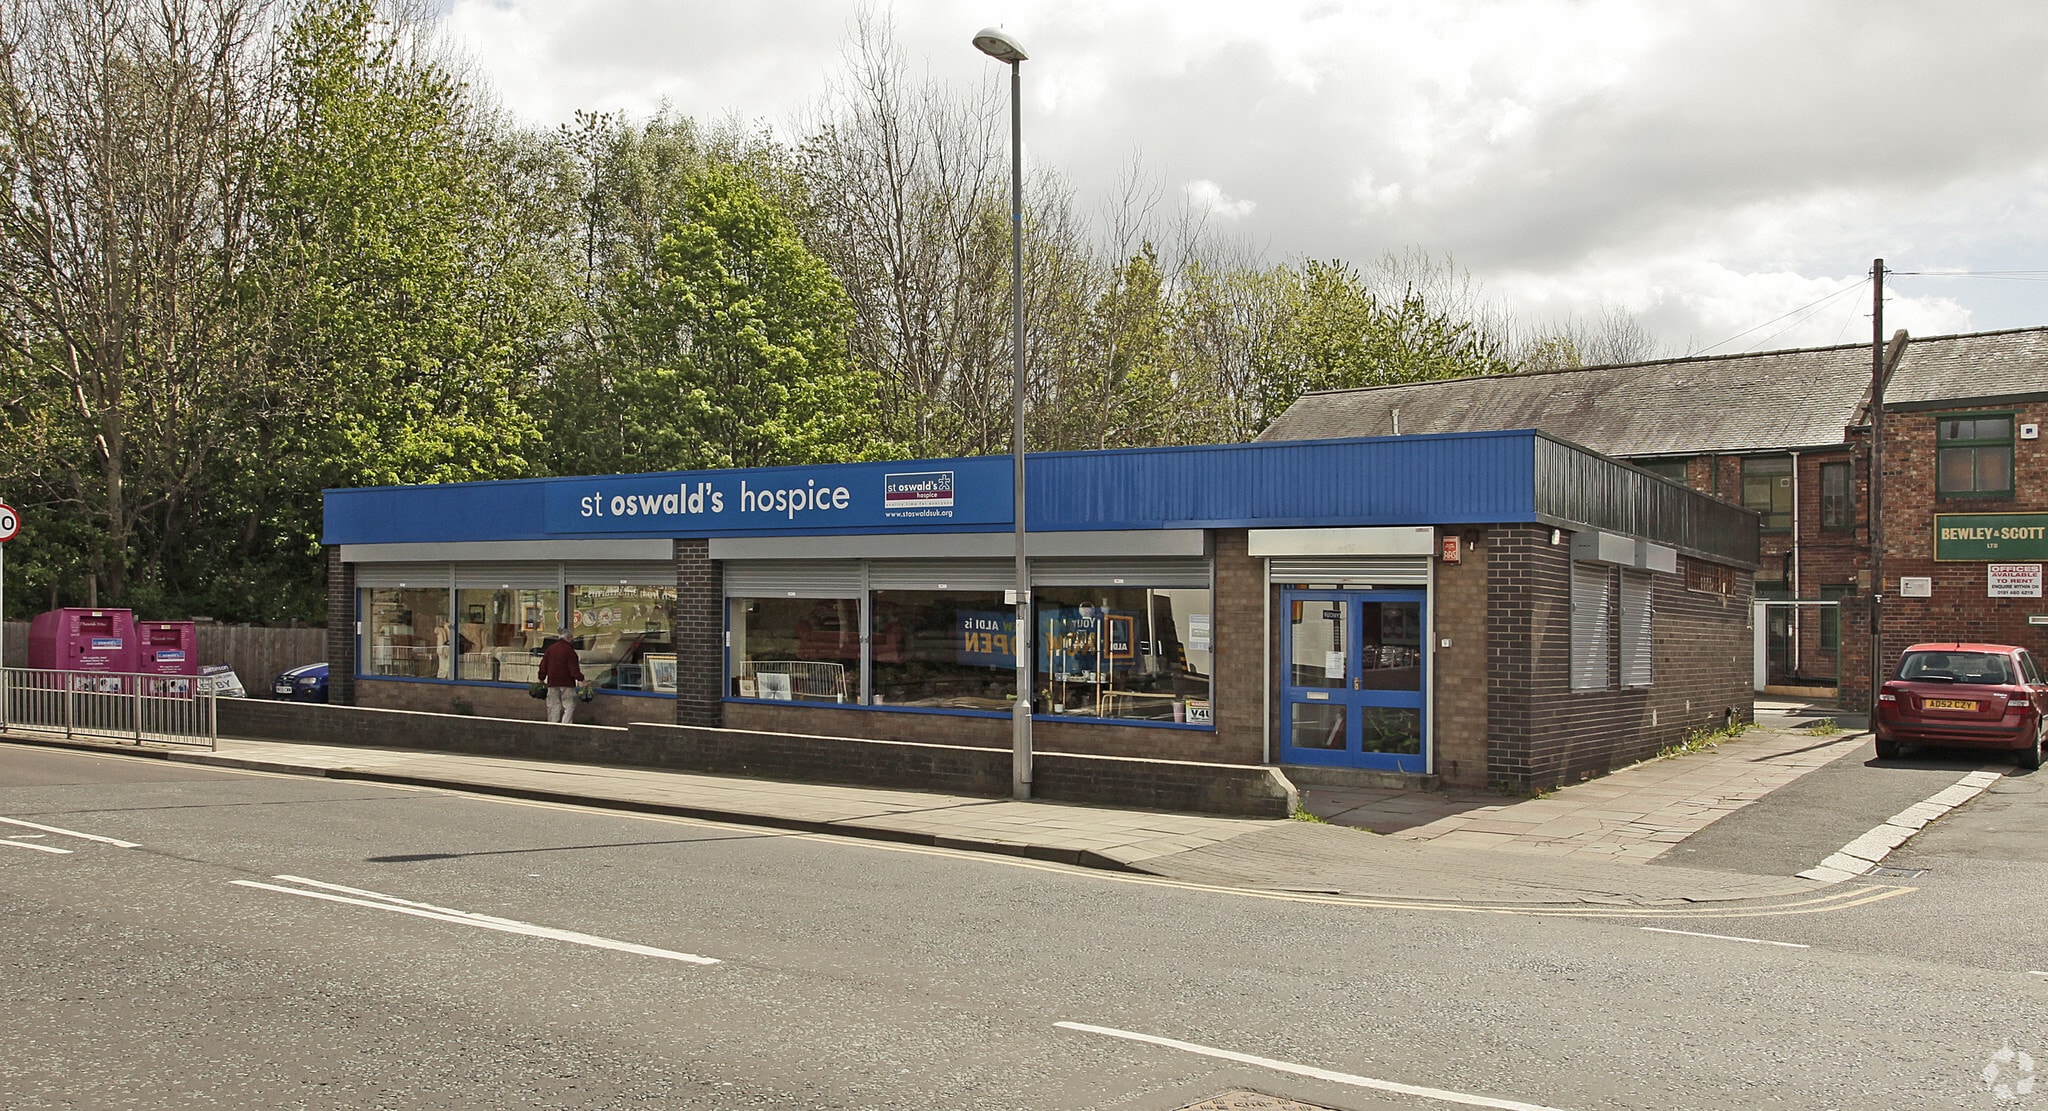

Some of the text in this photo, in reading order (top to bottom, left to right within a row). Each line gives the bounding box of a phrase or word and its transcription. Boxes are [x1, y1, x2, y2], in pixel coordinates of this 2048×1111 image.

[888, 481, 938, 492] st oswald's
[580, 479, 850, 519] st oswald's hospice
[885, 509, 953, 518] www.stoswaldsuk.org
[0, 515, 14, 530] 0
[1941, 527, 1994, 540] BEWLEY
[2001, 526, 2046, 540] SCOTT
[216, 680, 231, 688] BY
